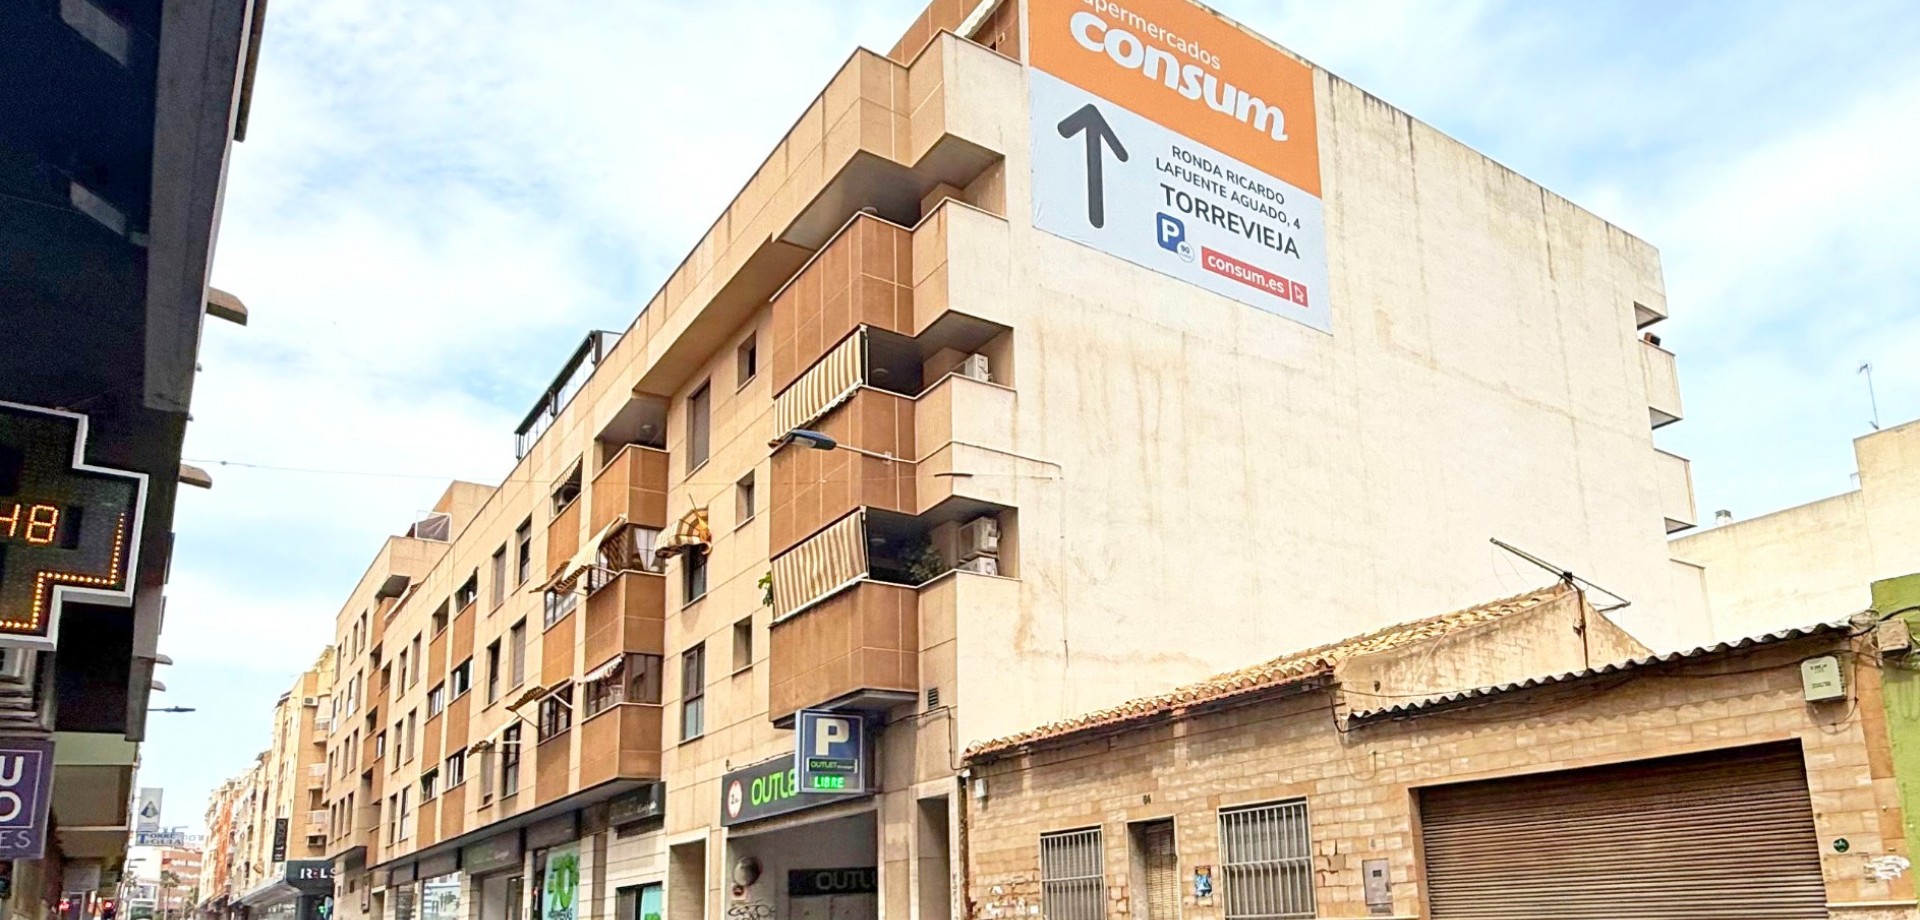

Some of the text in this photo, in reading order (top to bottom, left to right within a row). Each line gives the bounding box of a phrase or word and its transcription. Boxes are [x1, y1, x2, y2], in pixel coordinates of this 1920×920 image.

[1069, 11, 1289, 142] consum
[1156, 157, 1301, 230] LAFUENTE AGUADO, 4
[1171, 145, 1285, 205] RONDA RICARDO
[1160, 182, 1301, 260] TORREVIEJA
[1161, 217, 1180, 244] P
[1207, 255, 1285, 294] consum.es
[815, 717, 850, 756] P
[810, 761, 838, 769] OUTLET
[814, 776, 845, 788] LIBRE
